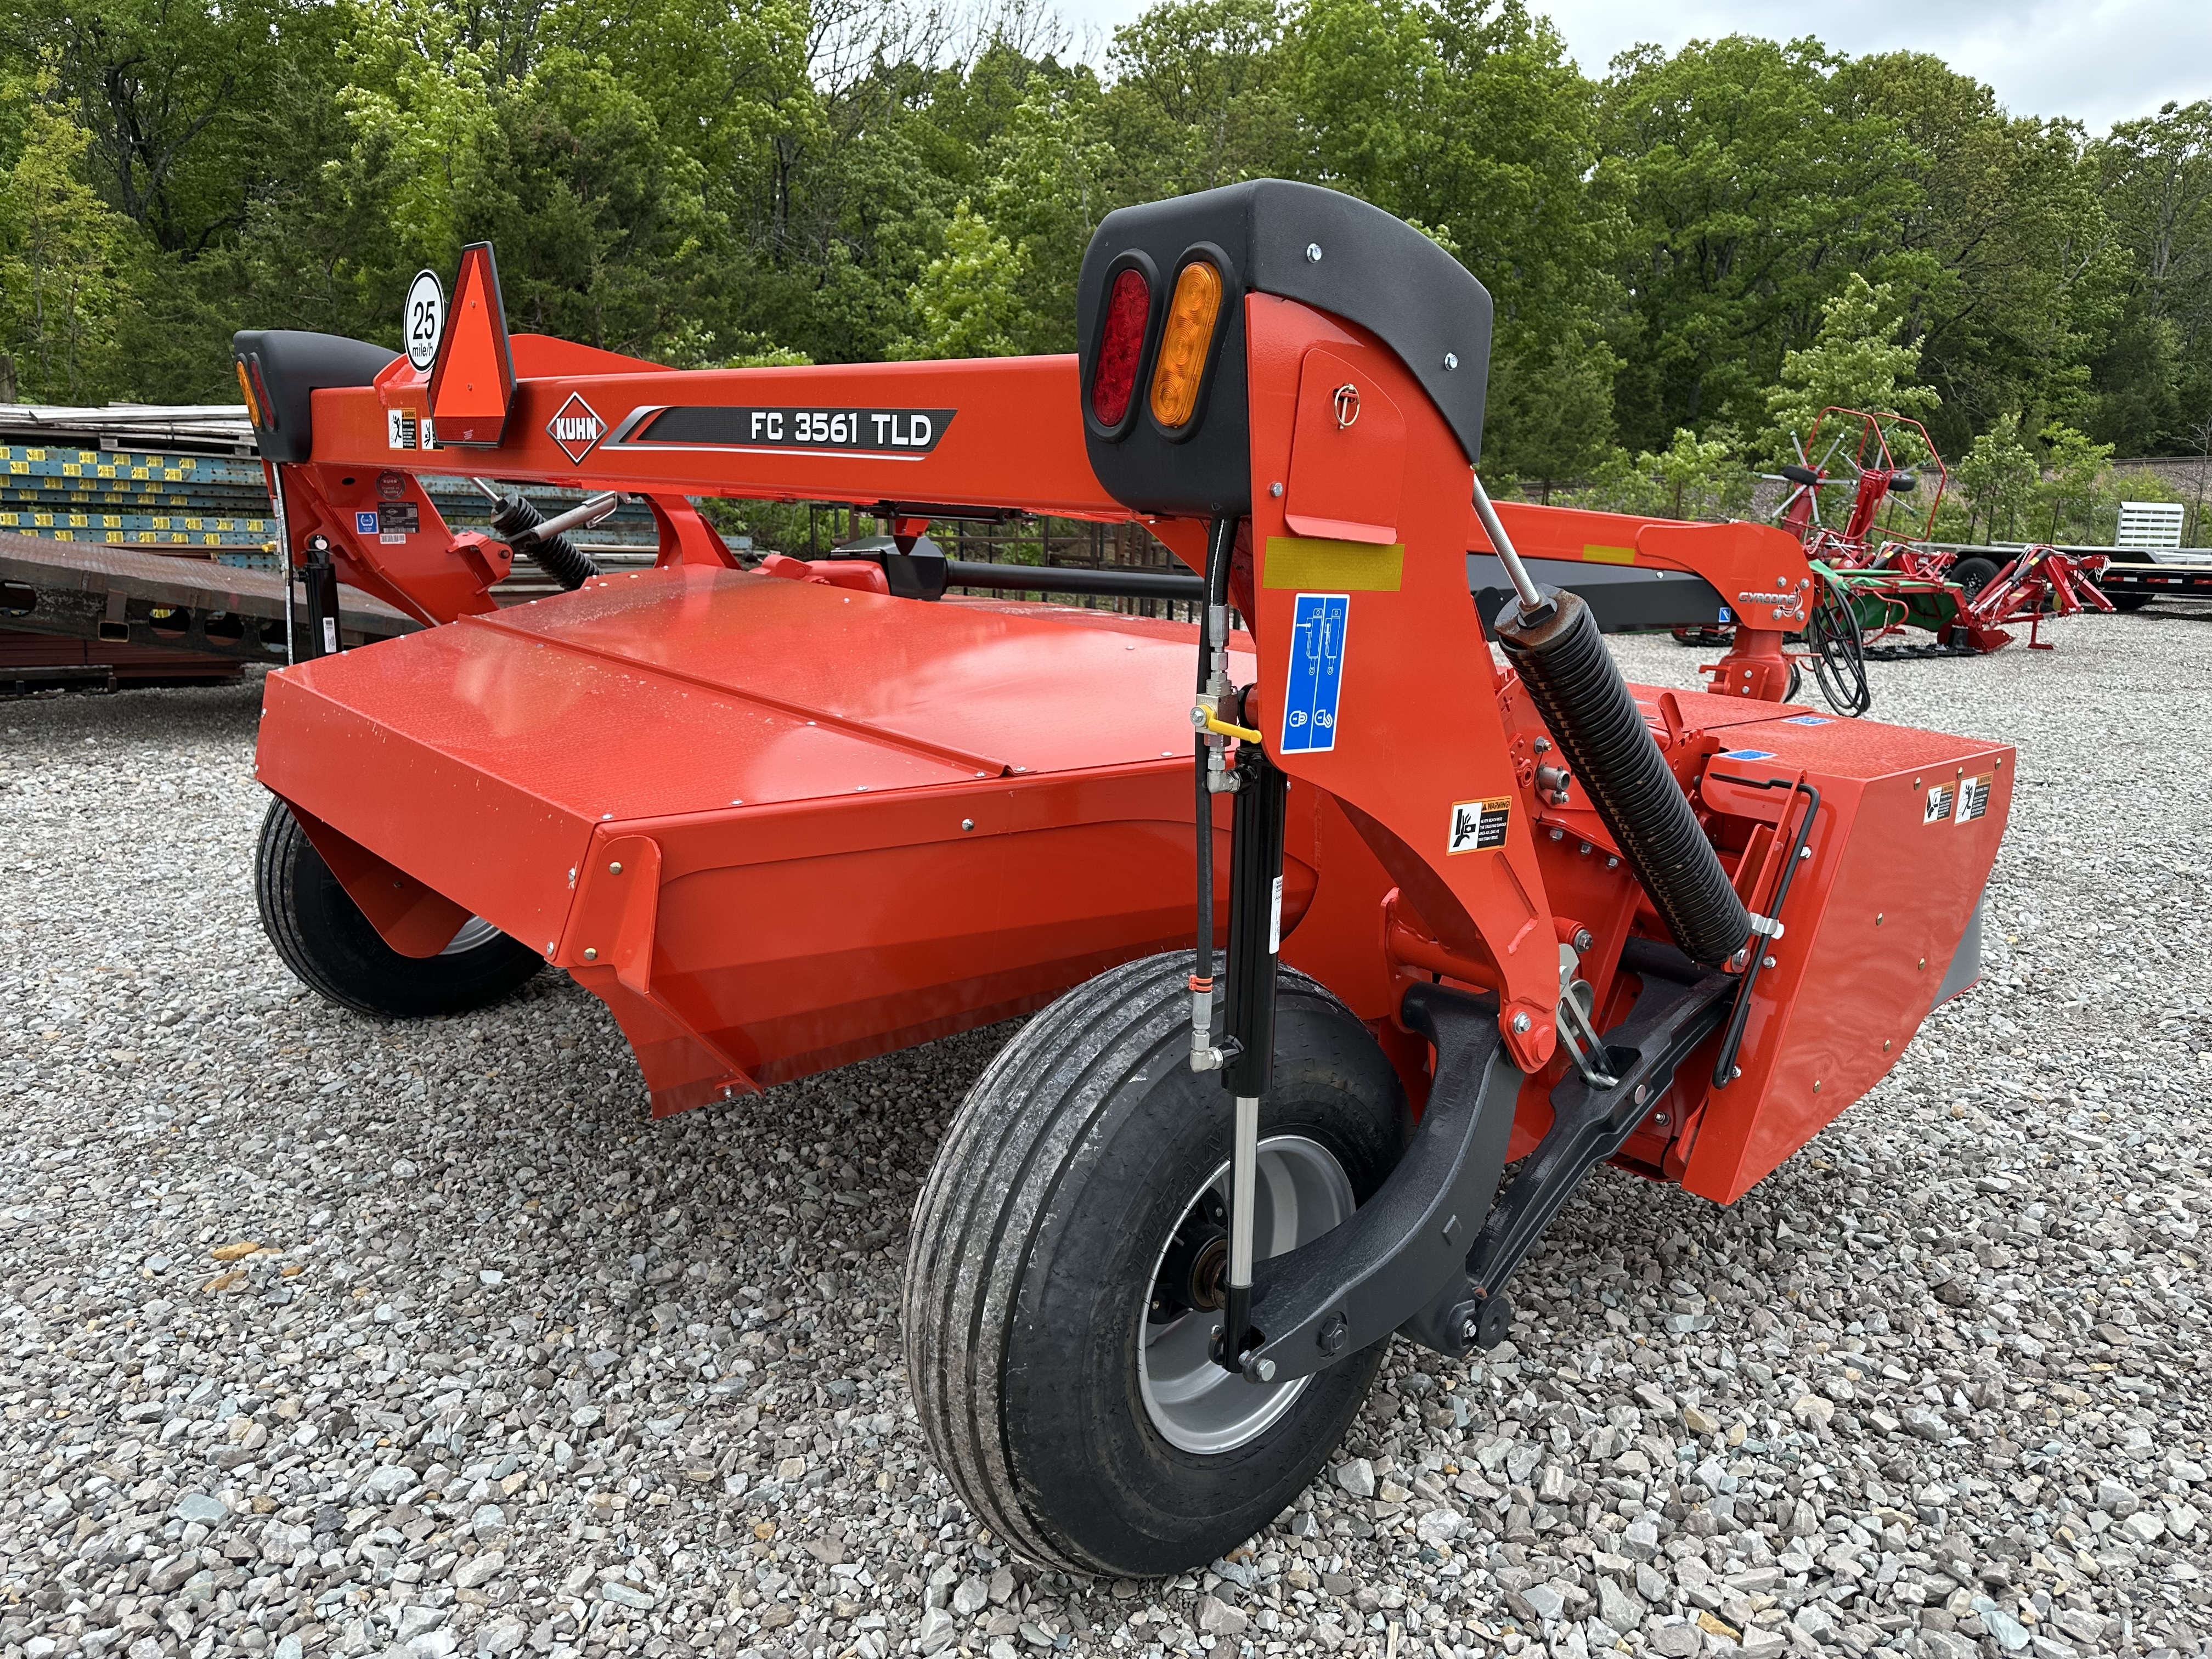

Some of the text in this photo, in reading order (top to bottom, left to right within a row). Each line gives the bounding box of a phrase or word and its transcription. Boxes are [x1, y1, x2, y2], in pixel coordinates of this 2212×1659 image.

[413, 301, 435, 340] 25
[413, 342, 433, 357] mile/h
[556, 417, 597, 441] KUHN
[752, 412, 932, 446] FC 3561 TLD
[1738, 591, 1796, 605] GYRODINE
[1488, 801, 1509, 810] WARNING
